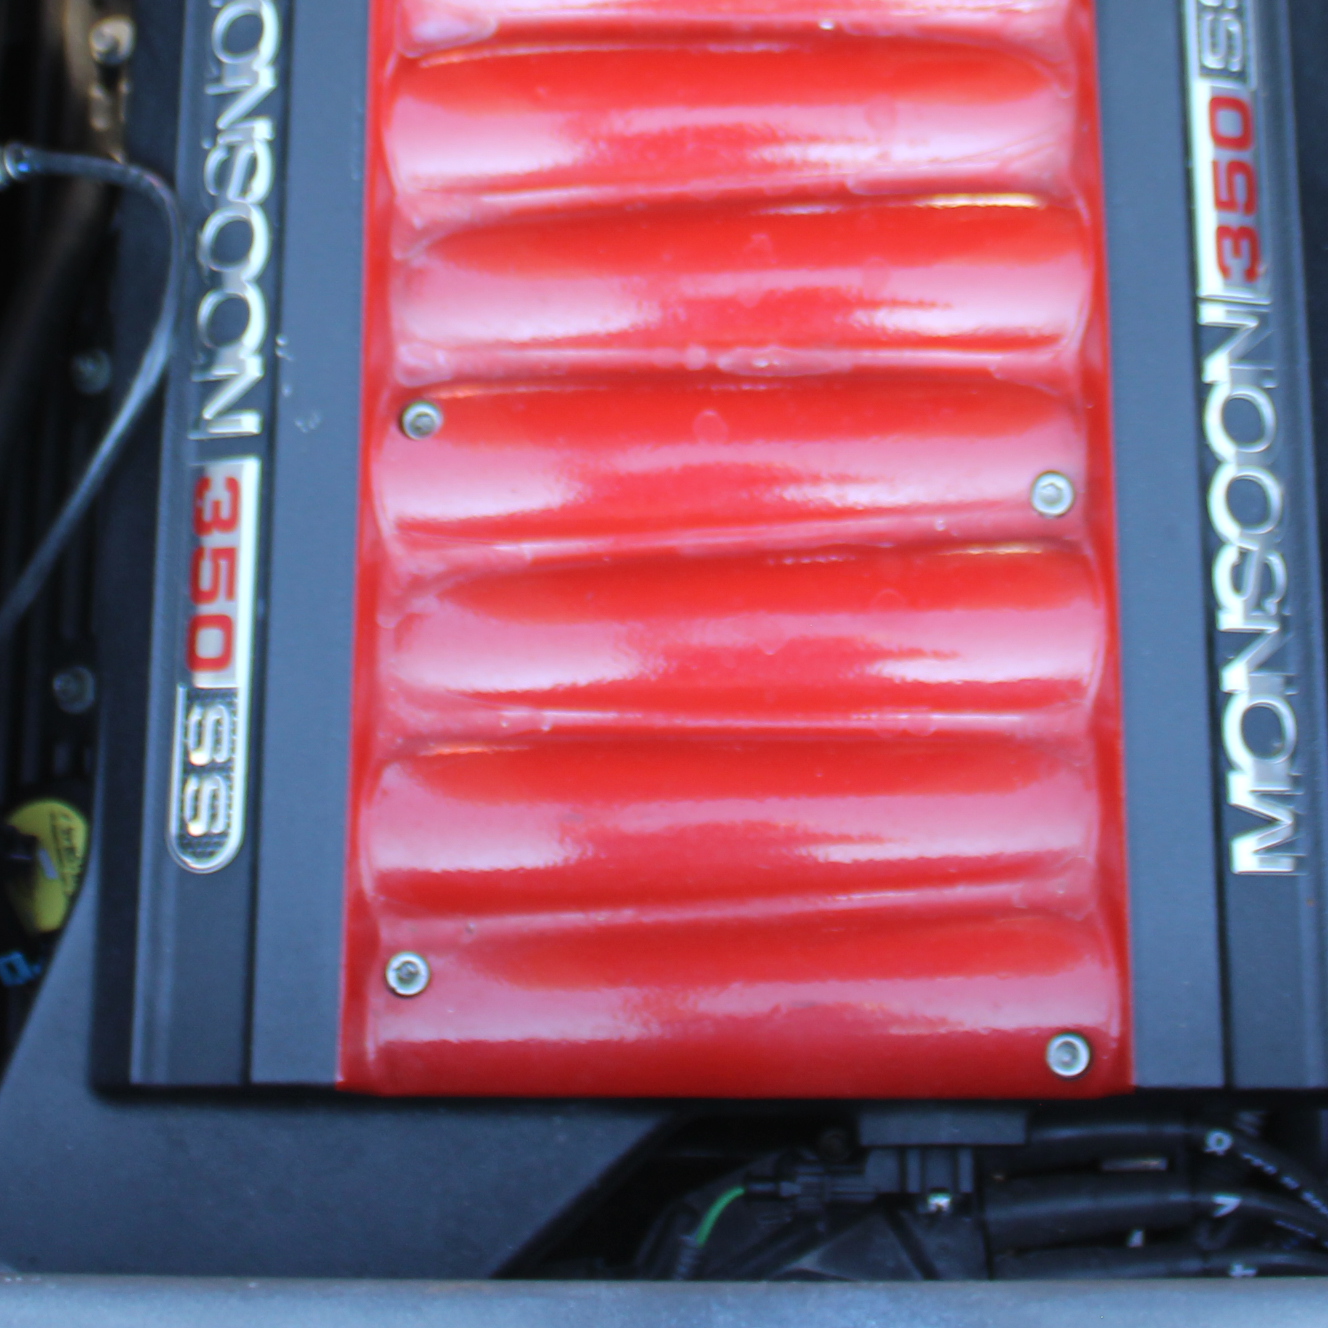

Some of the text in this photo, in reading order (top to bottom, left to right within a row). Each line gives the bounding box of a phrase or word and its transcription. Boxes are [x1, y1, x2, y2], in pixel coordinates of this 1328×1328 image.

[1208, 95, 1262, 282] 350
[186, 475, 240, 672] 350
[1197, 302, 1304, 874] MONSOON
[182, 704, 232, 838] SS
